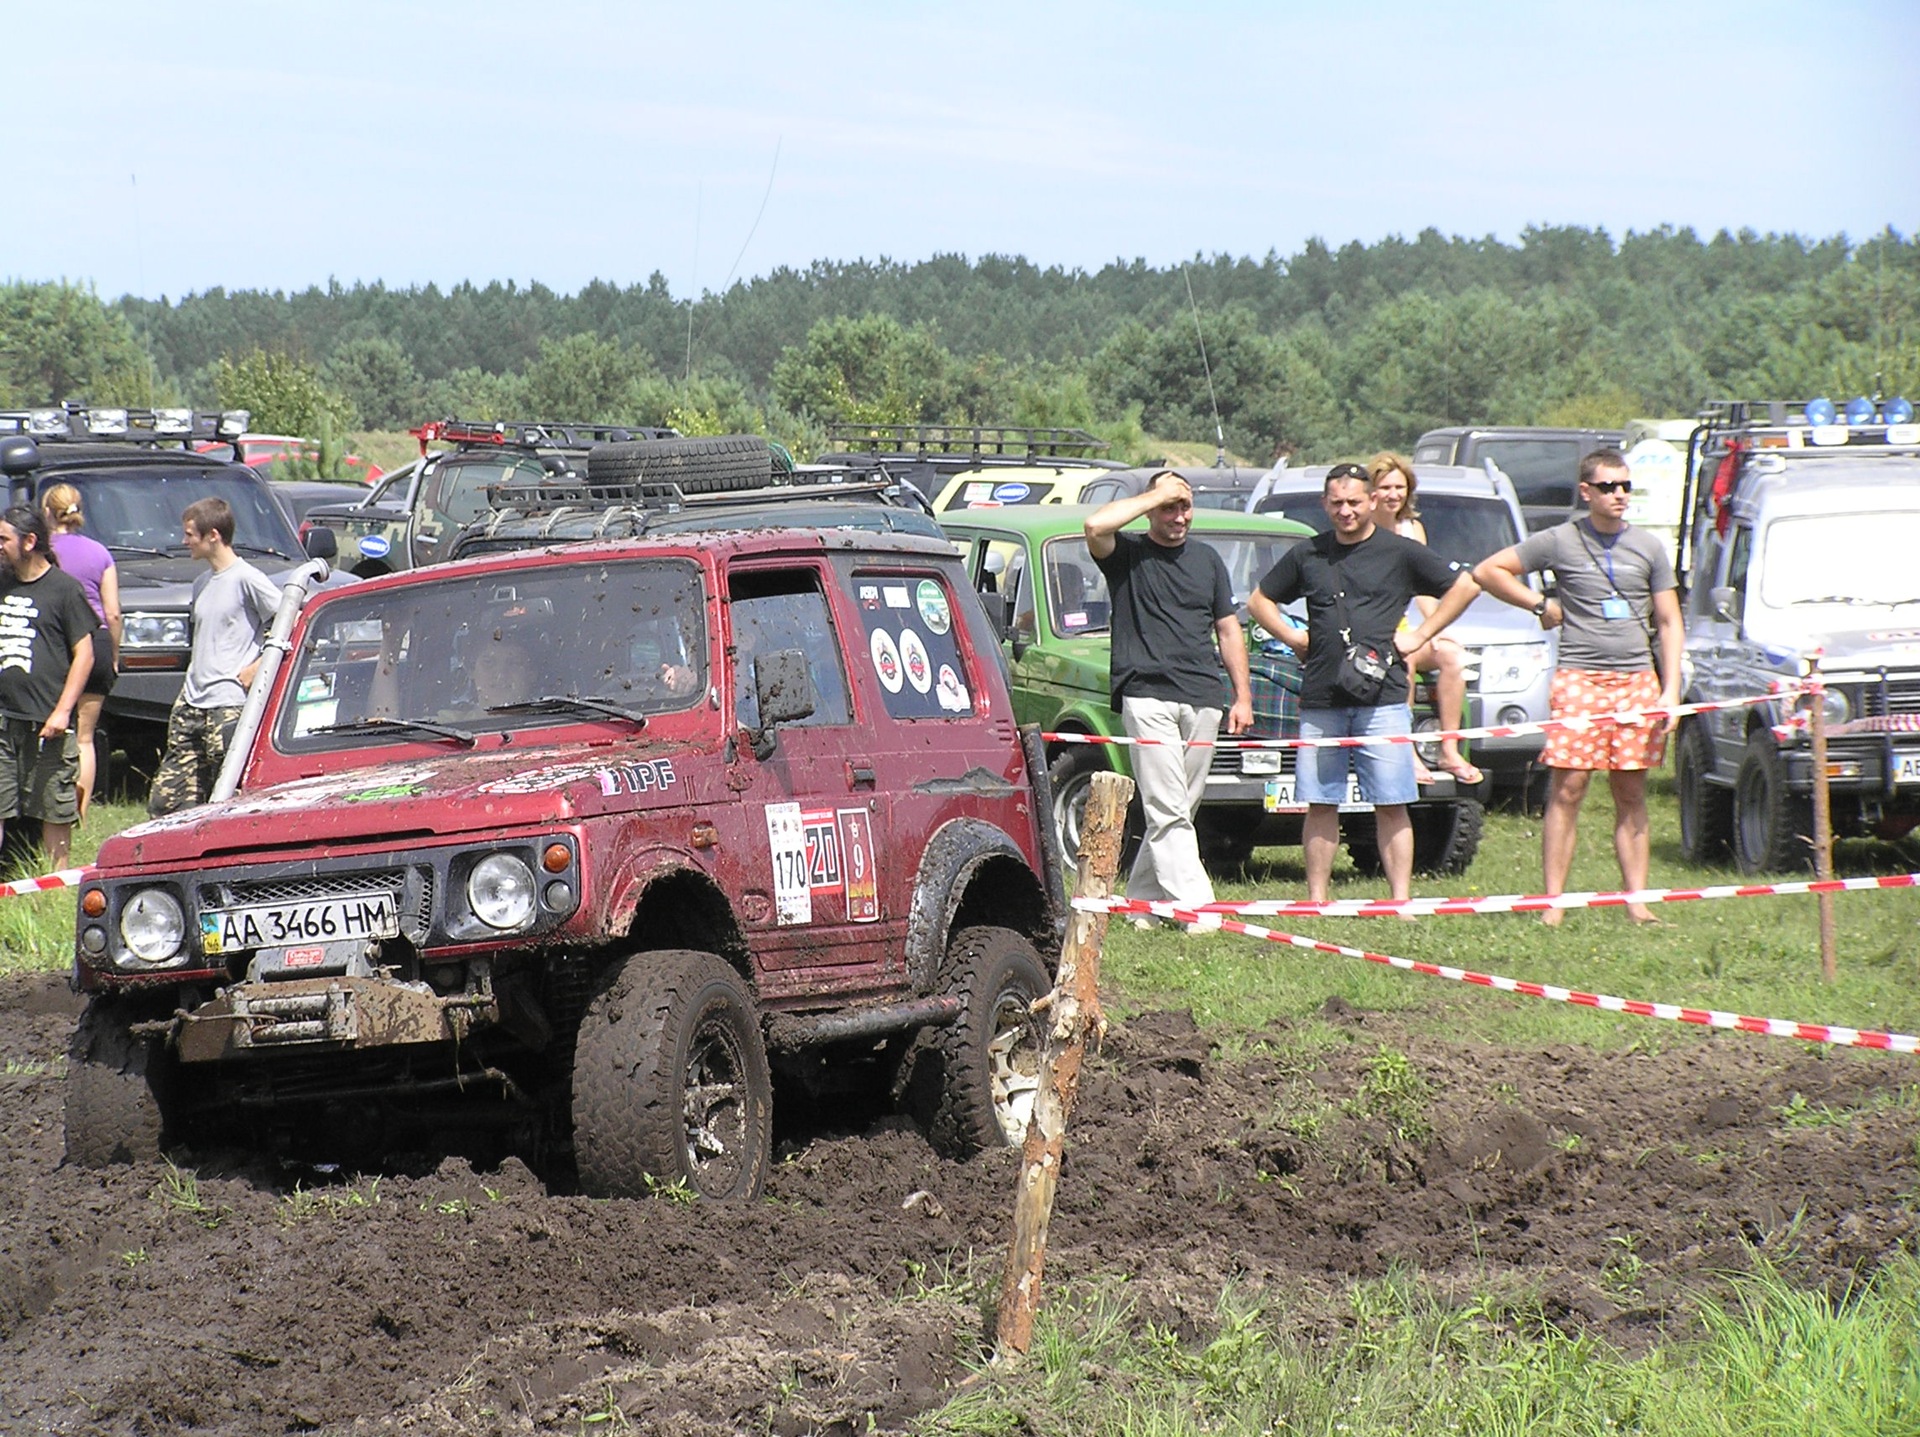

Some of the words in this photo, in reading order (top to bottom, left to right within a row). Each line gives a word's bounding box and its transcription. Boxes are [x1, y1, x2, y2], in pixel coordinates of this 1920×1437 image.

[776, 849, 806, 890] 170
[805, 825, 840, 886] 20
[853, 843, 865, 879] 9
[222, 914, 264, 947] AA
[267, 905, 337, 940] 3466
[342, 900, 387, 934] HM
